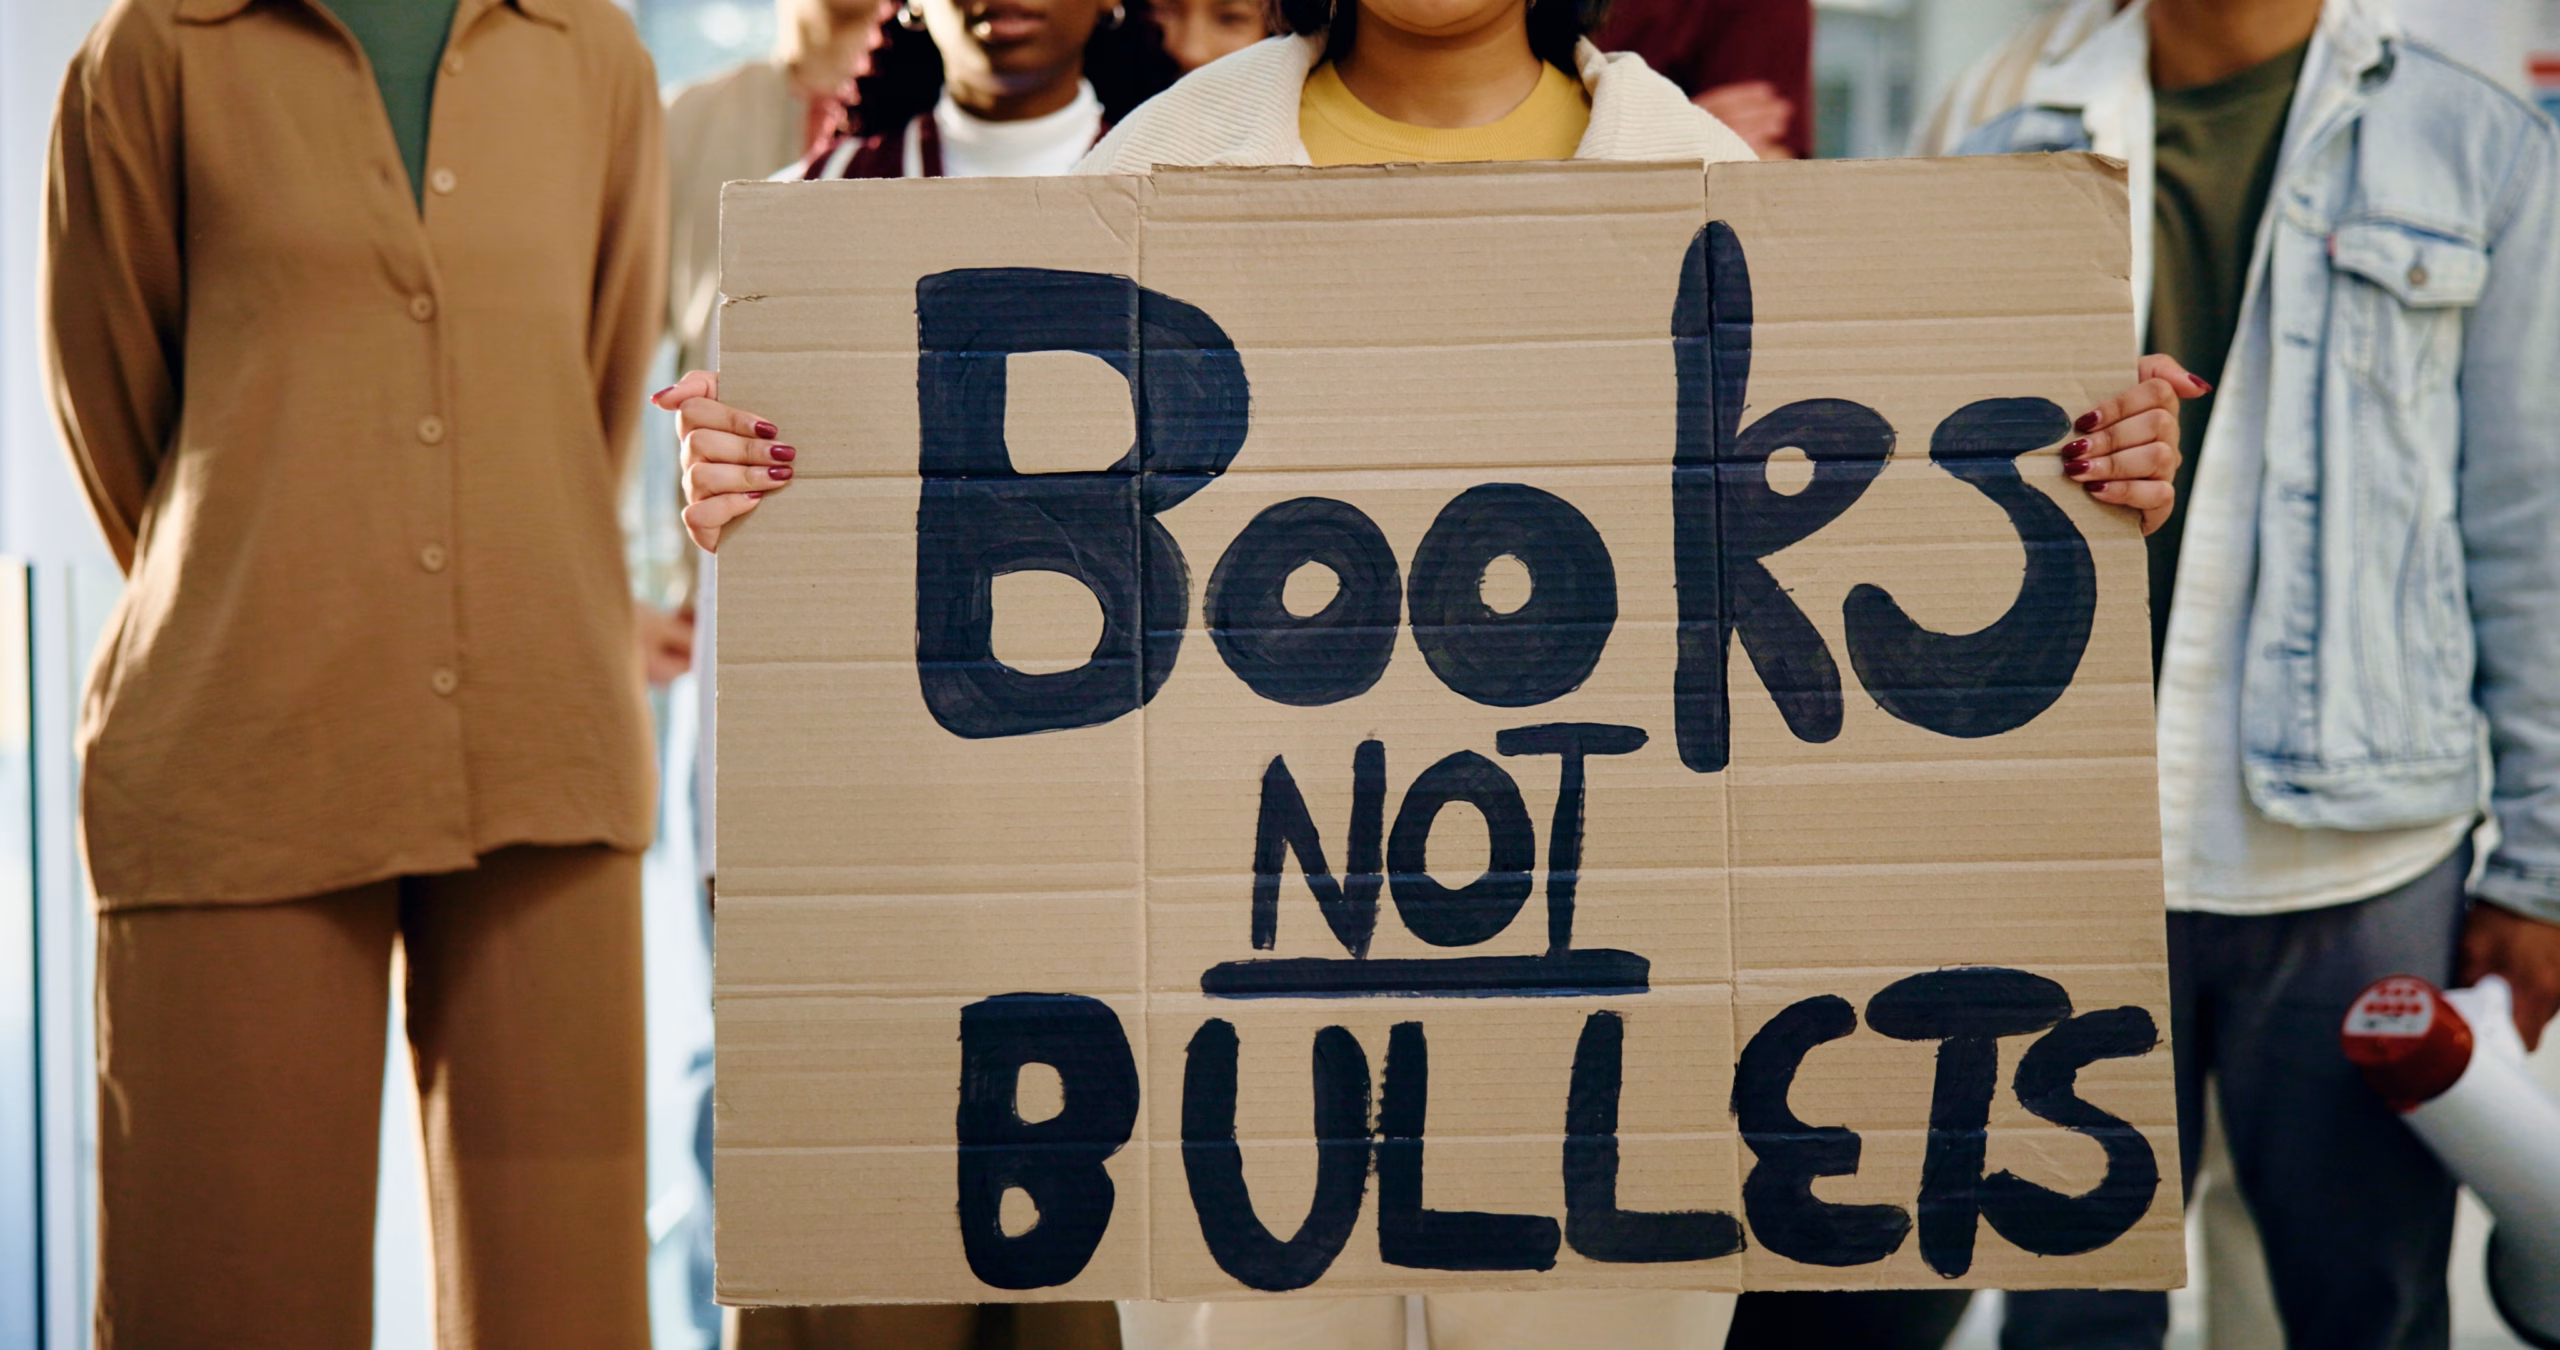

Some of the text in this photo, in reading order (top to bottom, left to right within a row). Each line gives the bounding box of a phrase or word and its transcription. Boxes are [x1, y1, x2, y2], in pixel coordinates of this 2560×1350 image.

[916, 221, 2097, 773] Books
[1252, 724, 1650, 958] NOT
[956, 968, 2162, 1292] BULLETS
